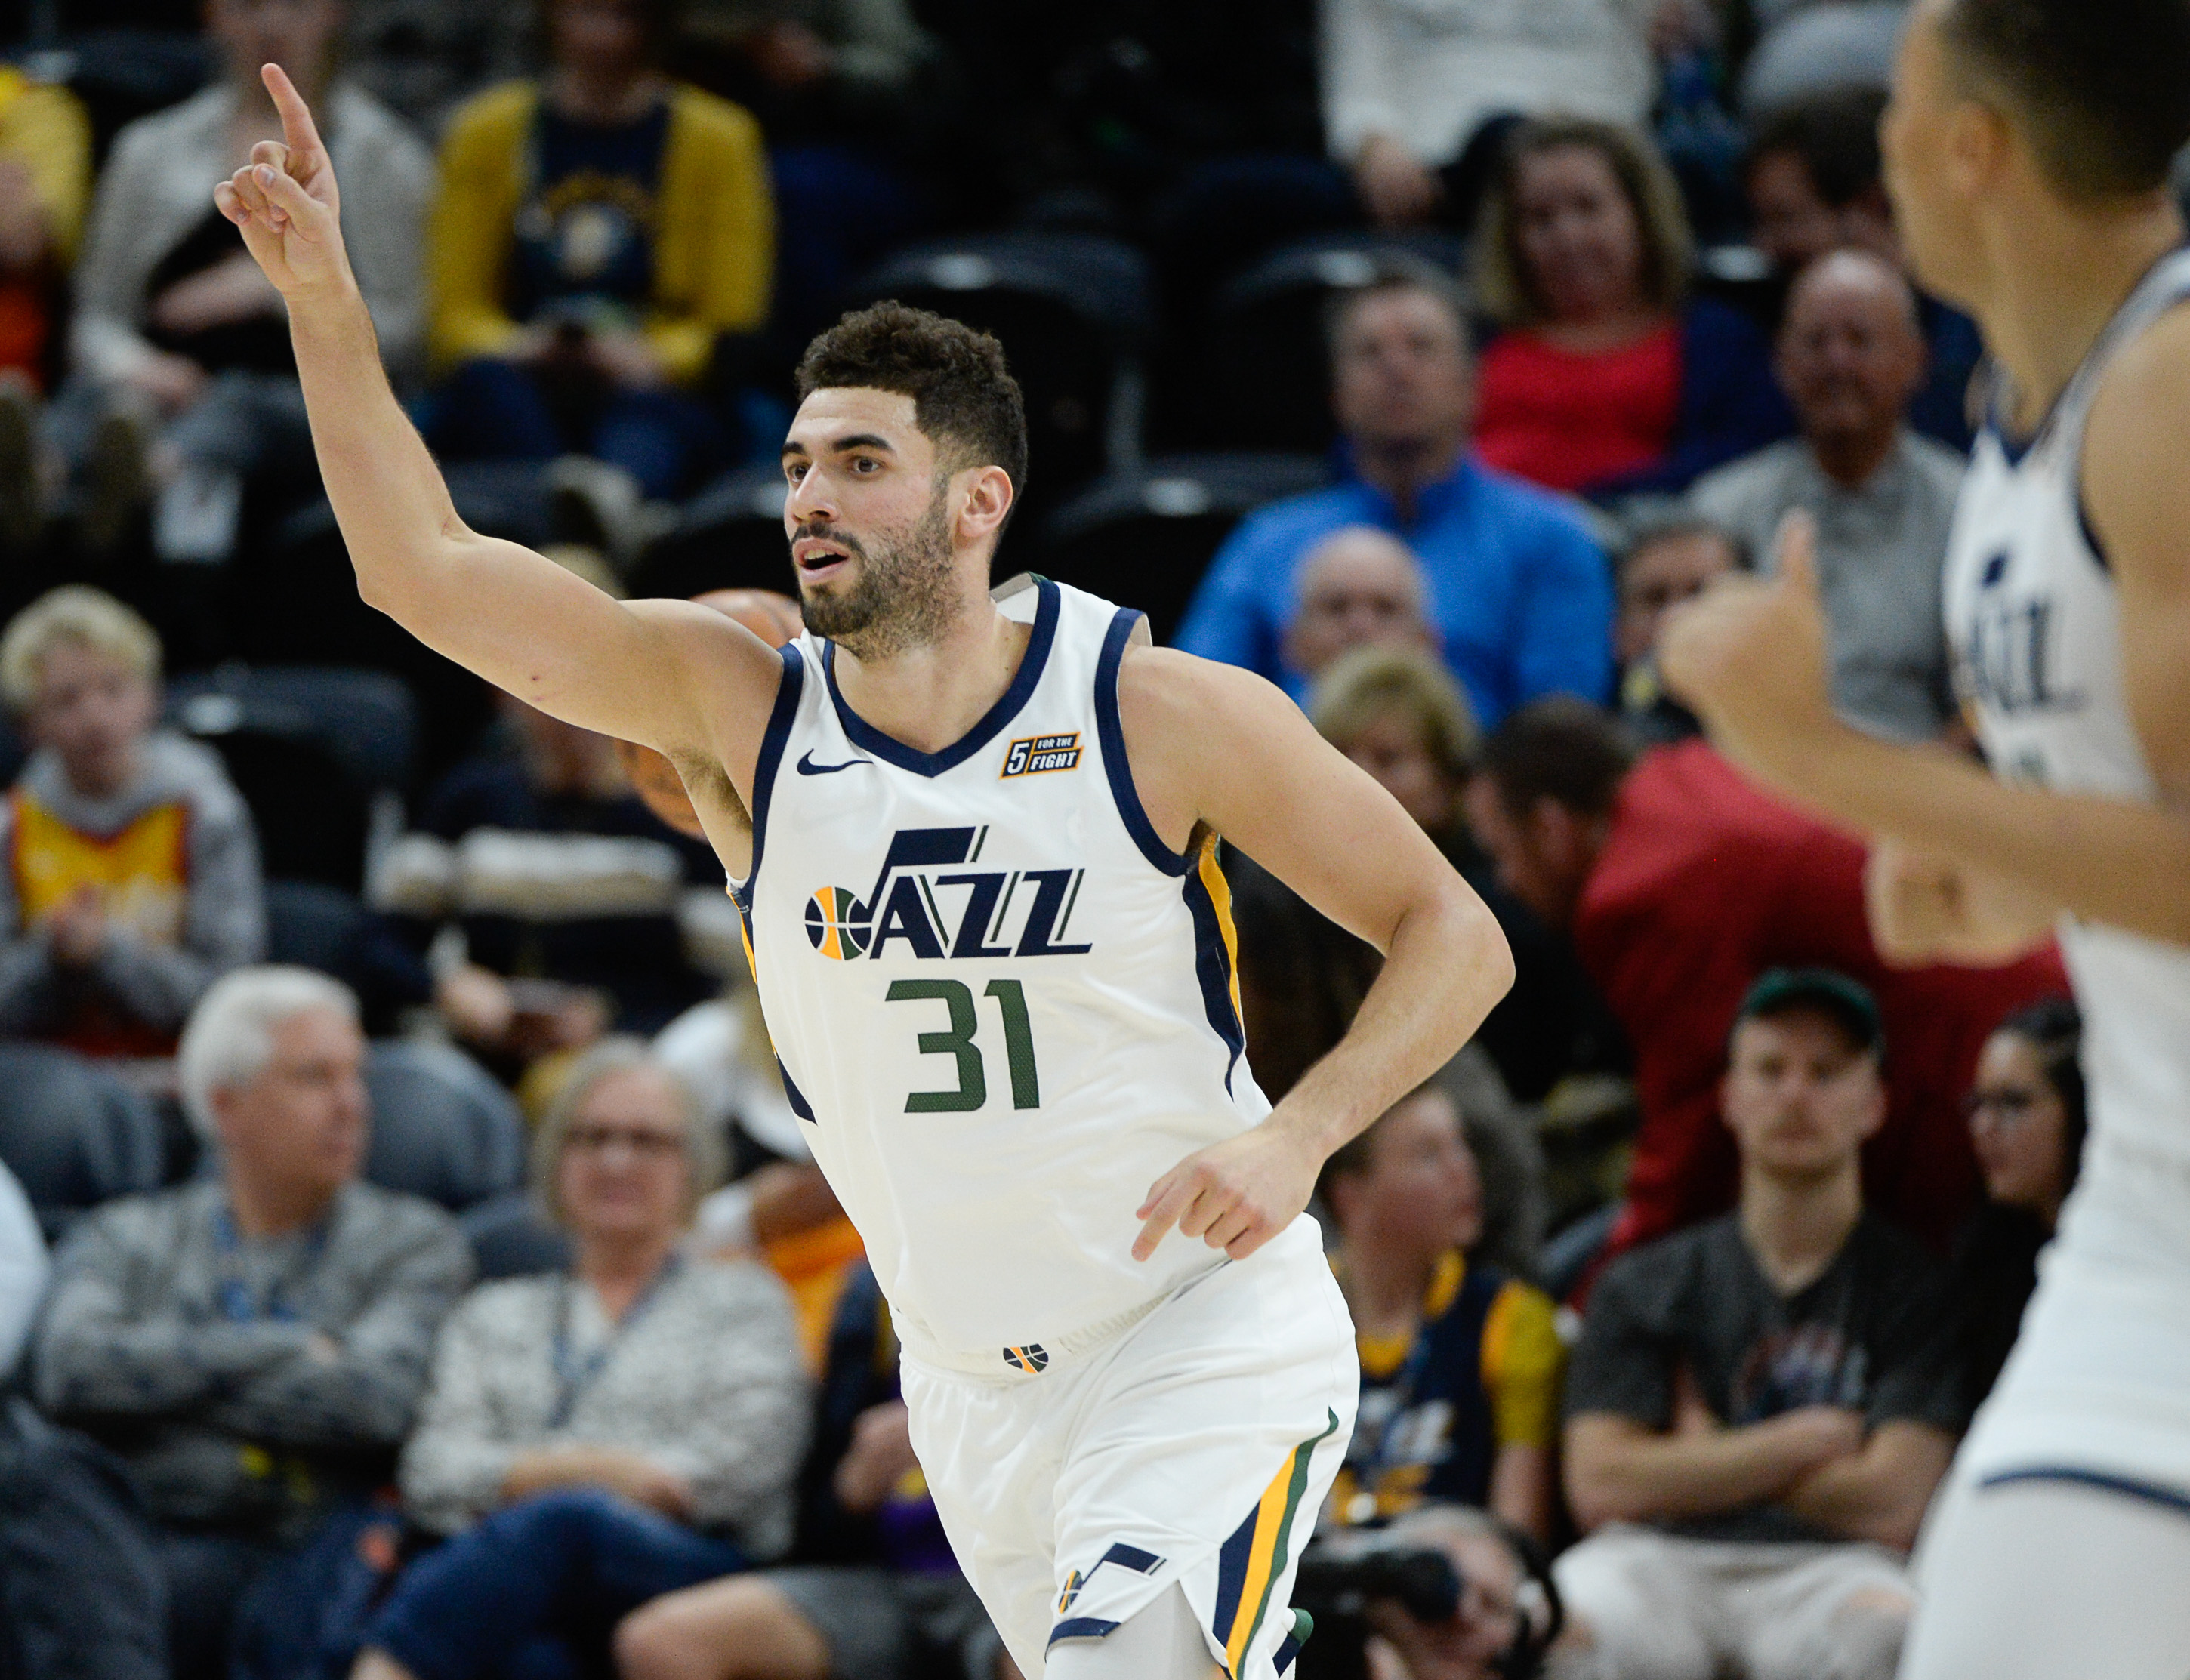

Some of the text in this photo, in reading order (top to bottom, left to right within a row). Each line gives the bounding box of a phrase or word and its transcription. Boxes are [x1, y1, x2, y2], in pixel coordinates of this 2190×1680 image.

[1007, 742, 1029, 774] 5
[1038, 738, 1072, 749] FOR THE
[1030, 752, 1077, 770] FIGHT
[805, 825, 1093, 960] JAZZ
[885, 979, 1041, 1114] 31
